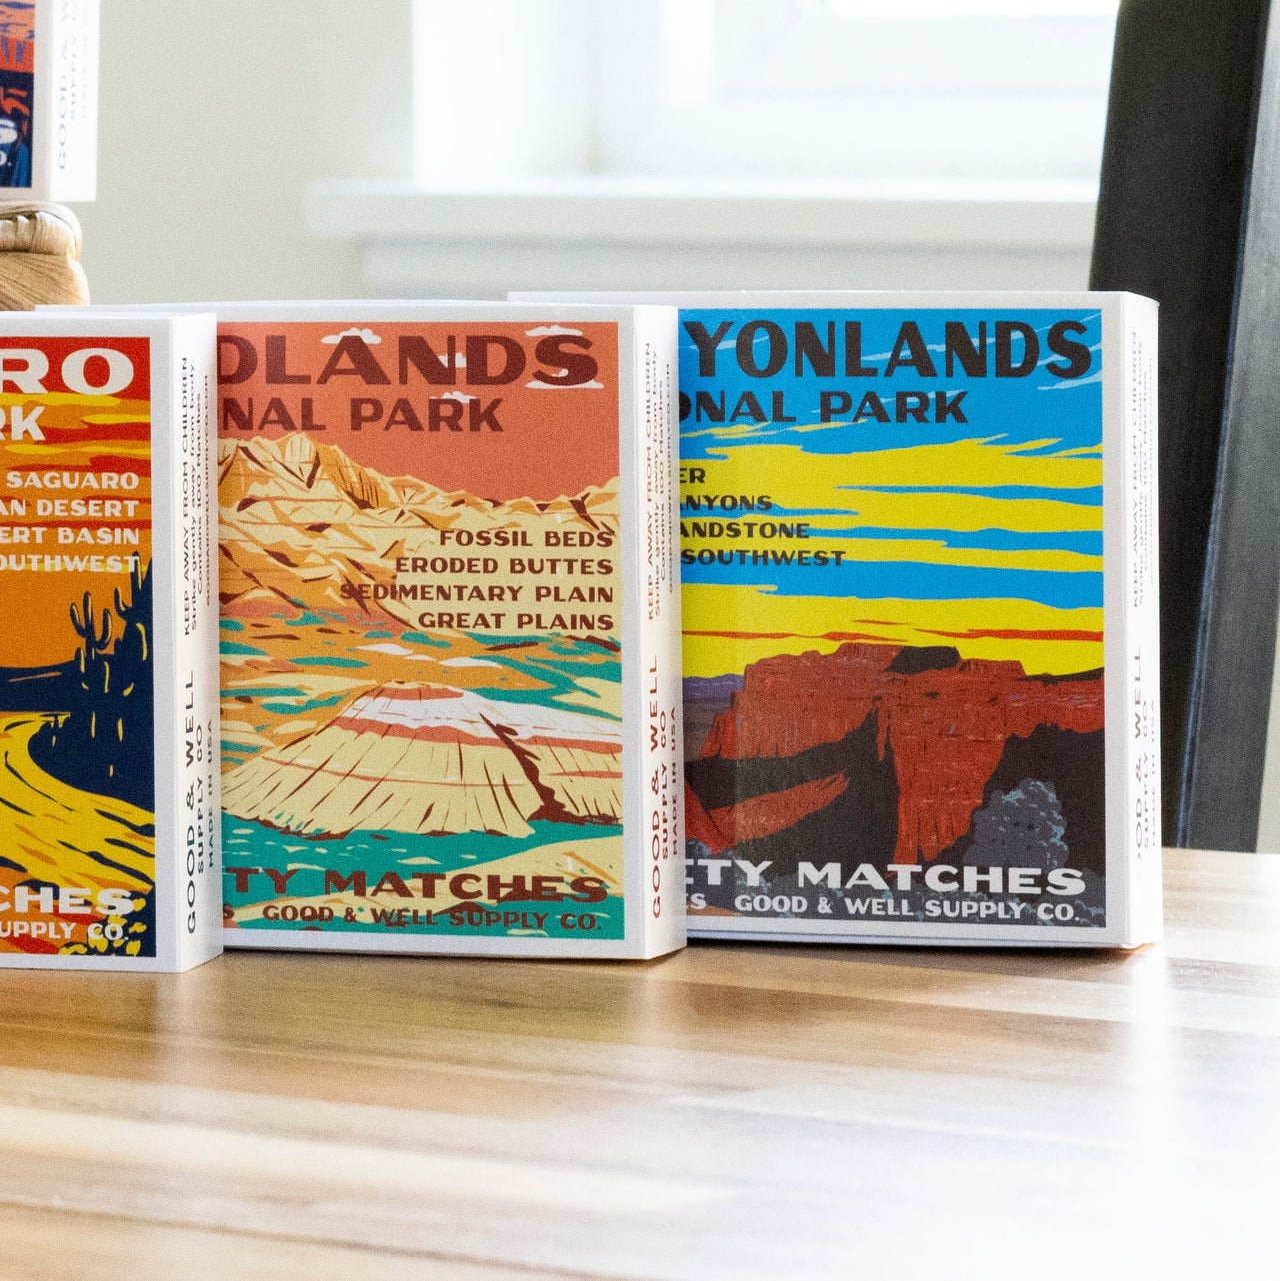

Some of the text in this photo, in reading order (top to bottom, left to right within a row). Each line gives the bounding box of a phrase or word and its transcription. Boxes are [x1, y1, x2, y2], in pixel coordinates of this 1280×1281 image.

[217, 334, 598, 386] DLANDS
[683, 319, 1091, 379] YONLANDS
[350, 398, 504, 432] PARK
[819, 390, 968, 424] PARK
[6, 471, 139, 490] SAGUARO
[36, 499, 138, 517] DESERT
[58, 527, 139, 545] BASIN
[439, 530, 614, 548] FOSSIL BEDS
[395, 558, 614, 575] ERODED BUTTES
[680, 549, 846, 567] SOUTHWEST
[340, 584, 614, 603] SEDIMENTARY PLAIN
[418, 612, 614, 631] GREAT PLAINS
[650, 654, 658, 752] WELL
[185, 670, 194, 767] WELL
[651, 810, 660, 918] GOOD
[798, 861, 1086, 895] MATCHES
[187, 824, 196, 934] GOOD
[324, 871, 608, 904] MATCHES
[263, 904, 334, 922] GOOD
[344, 906, 357, 923] &
[370, 908, 438, 926] WELL
[450, 909, 551, 929] SUPPLY
[734, 895, 808, 913] GOOD
[818, 897, 832, 914] &
[845, 897, 914, 916] WELL
[925, 899, 1027, 919] SUPPLY
